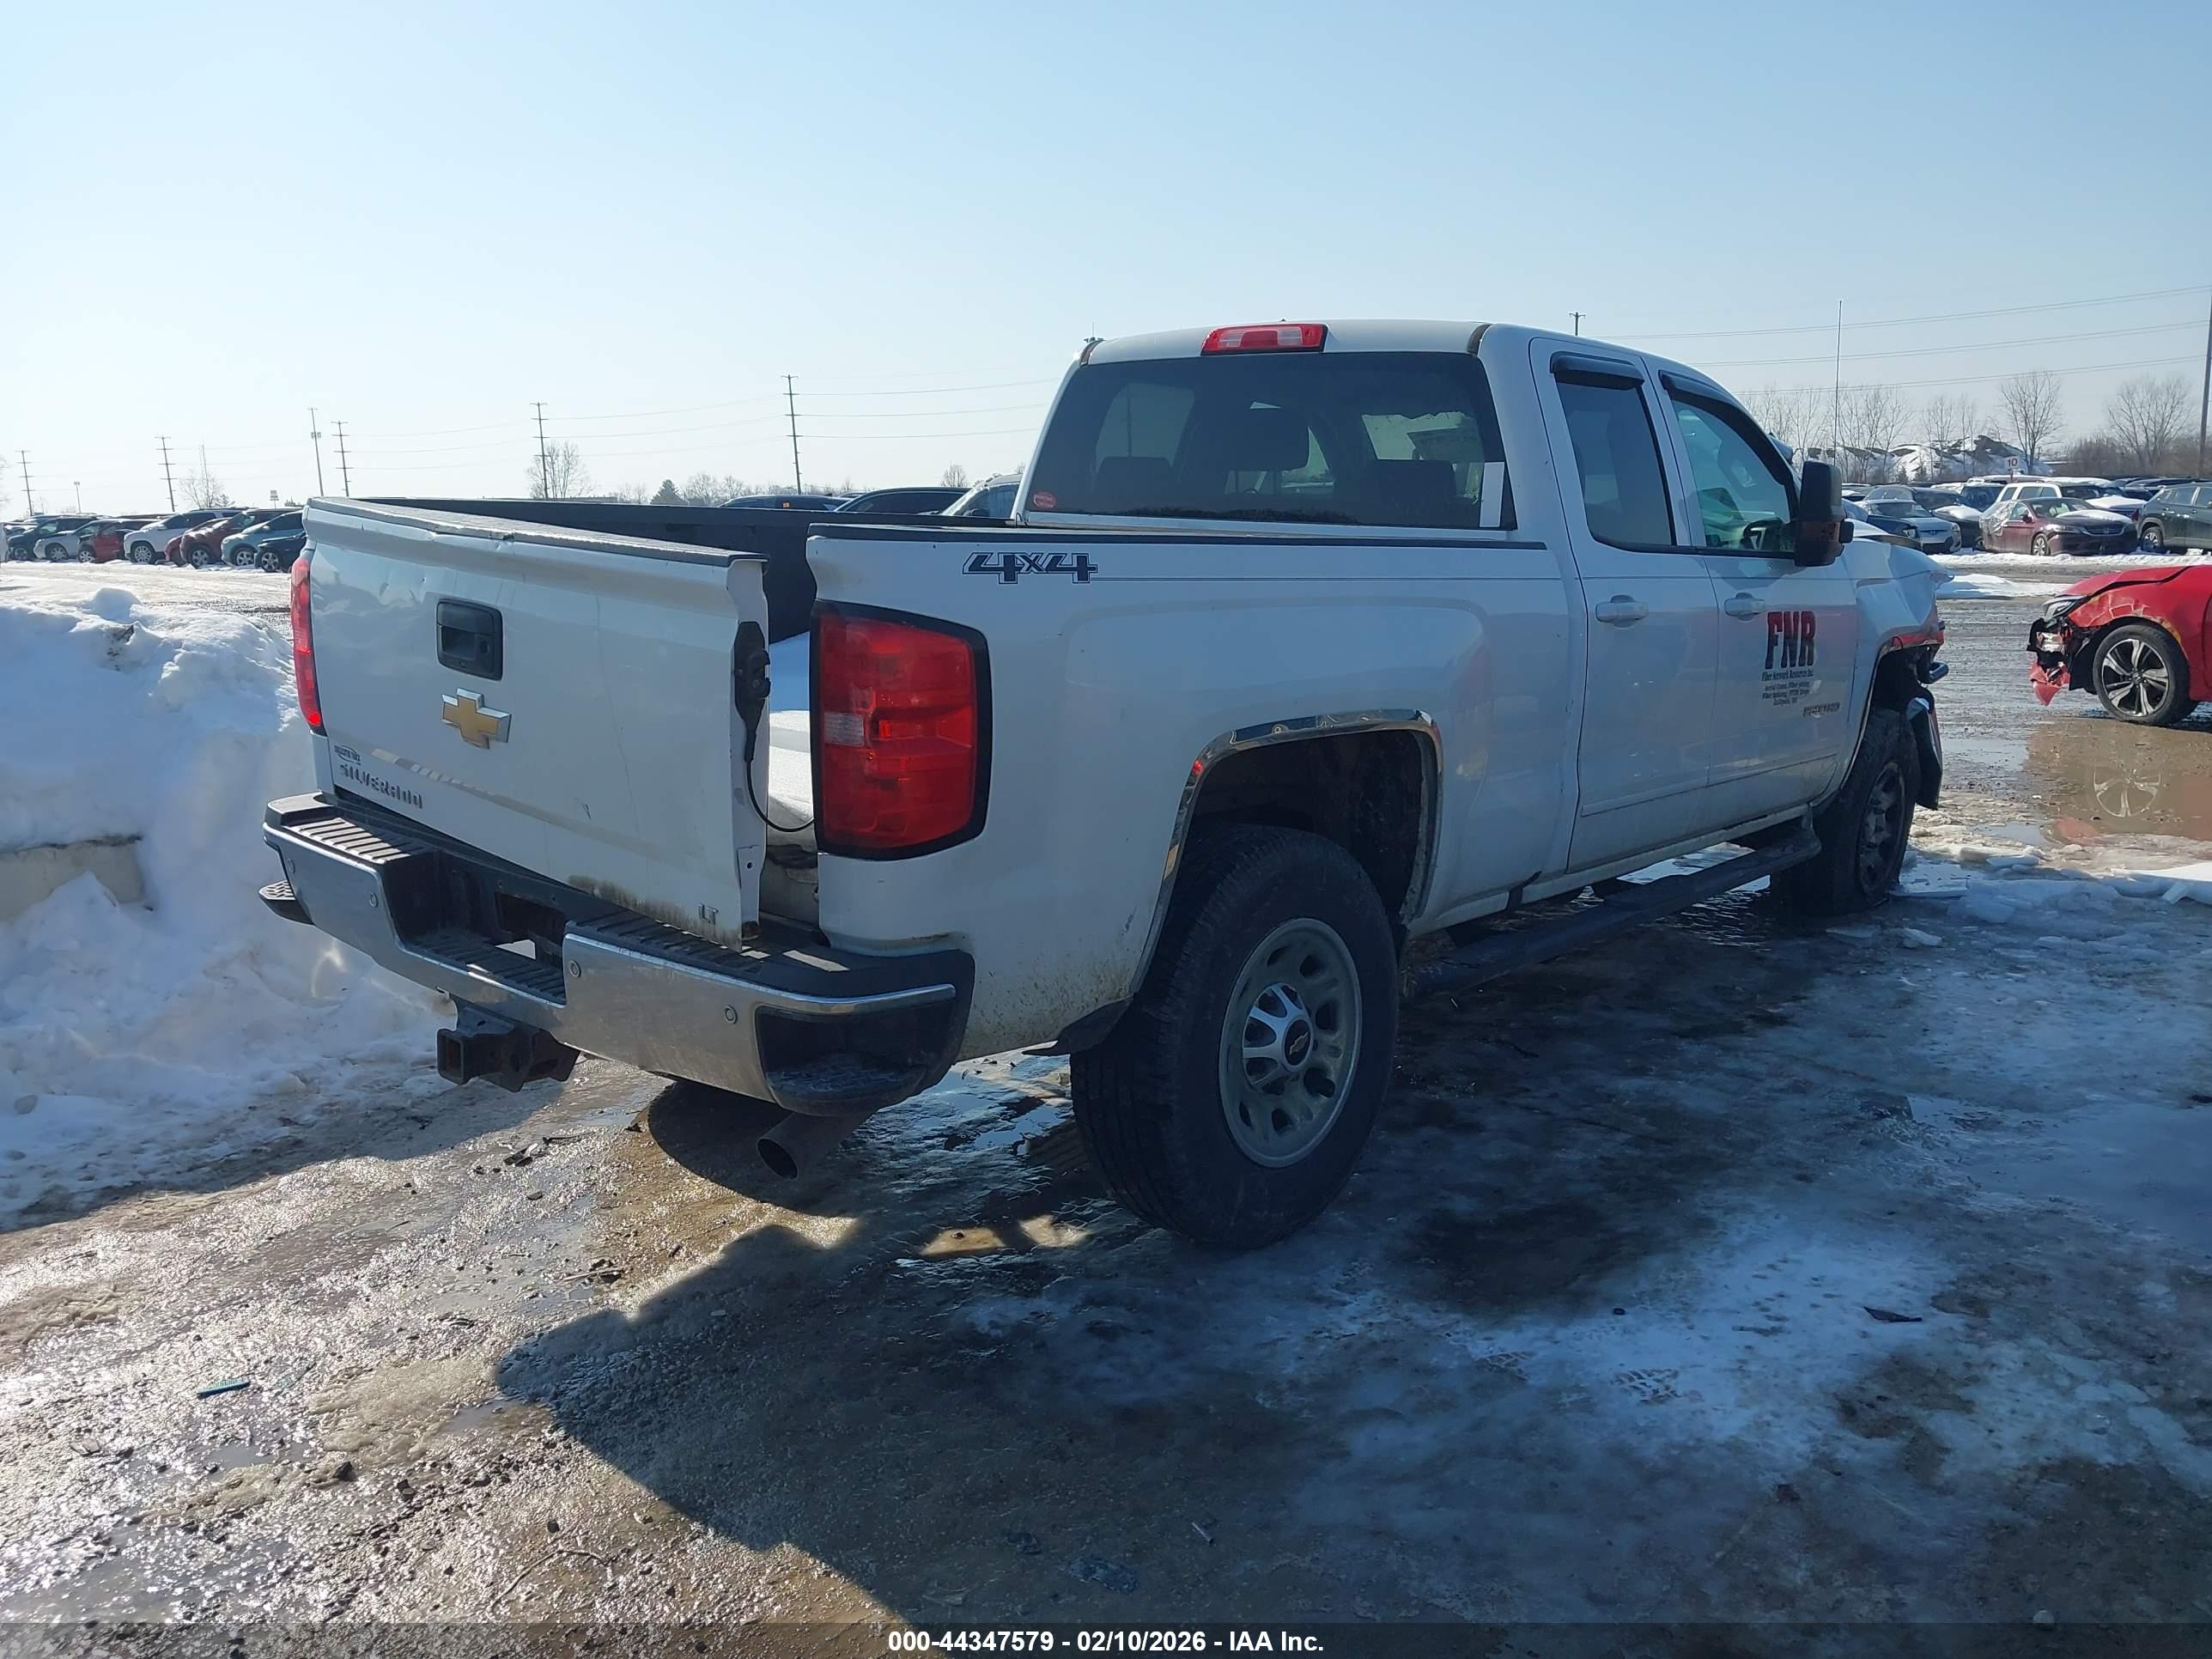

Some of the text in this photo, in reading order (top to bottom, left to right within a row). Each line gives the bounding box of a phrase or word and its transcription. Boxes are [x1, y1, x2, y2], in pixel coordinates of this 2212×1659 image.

[2007, 458, 2018, 468] 10
[1765, 611, 1816, 670] FNR
[340, 763, 423, 809] SILVERADO
[697, 903, 719, 925] LT
